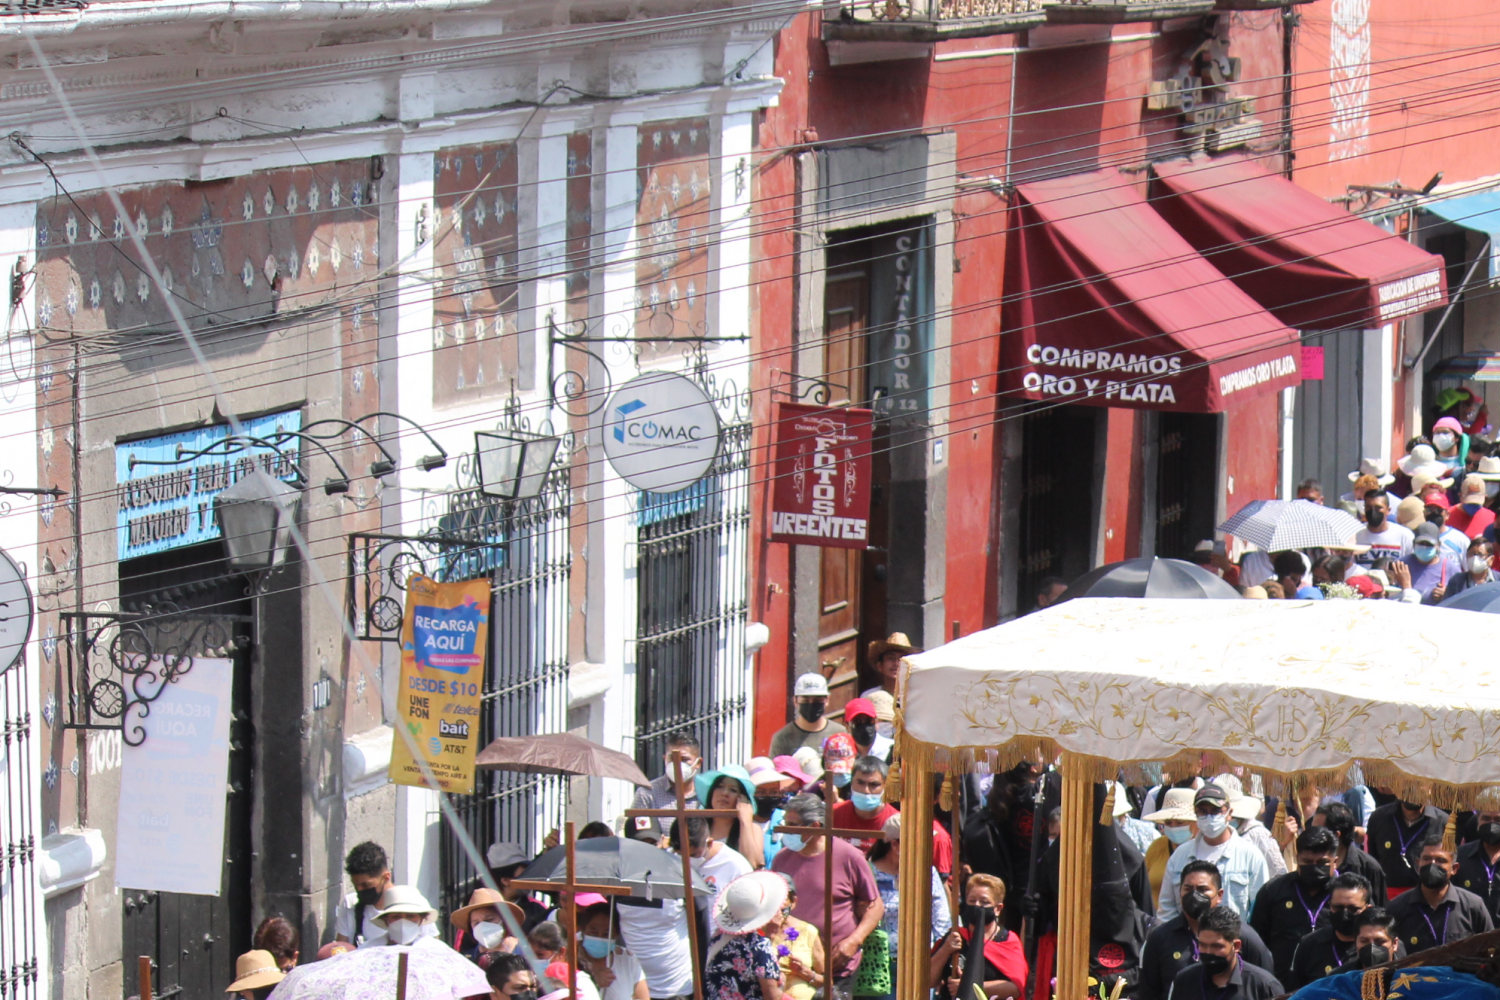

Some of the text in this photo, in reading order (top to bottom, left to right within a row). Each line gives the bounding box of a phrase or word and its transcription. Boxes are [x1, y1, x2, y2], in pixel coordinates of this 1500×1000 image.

[894, 236, 912, 389] CONTADOR
[1026, 343, 1183, 377] COMPRAMOS
[1219, 365, 1256, 396] COMPRAMOS
[1275, 353, 1297, 378] PLATA
[1023, 371, 1177, 404] ORO Y PLATA
[899, 397, 918, 411] 12
[628, 420, 702, 441] COMAC
[812, 436, 838, 516] FOTOS
[198, 502, 208, 531] Y
[772, 511, 868, 540] URGENTES
[414, 615, 476, 632] RECARGA
[424, 633, 466, 651] AQUÍ
[409, 676, 478, 697] DESDE $10
[410, 695, 430, 708] UNE
[409, 706, 430, 720] FON
[440, 720, 468, 736] bait
[444, 744, 467, 755] AT&T
